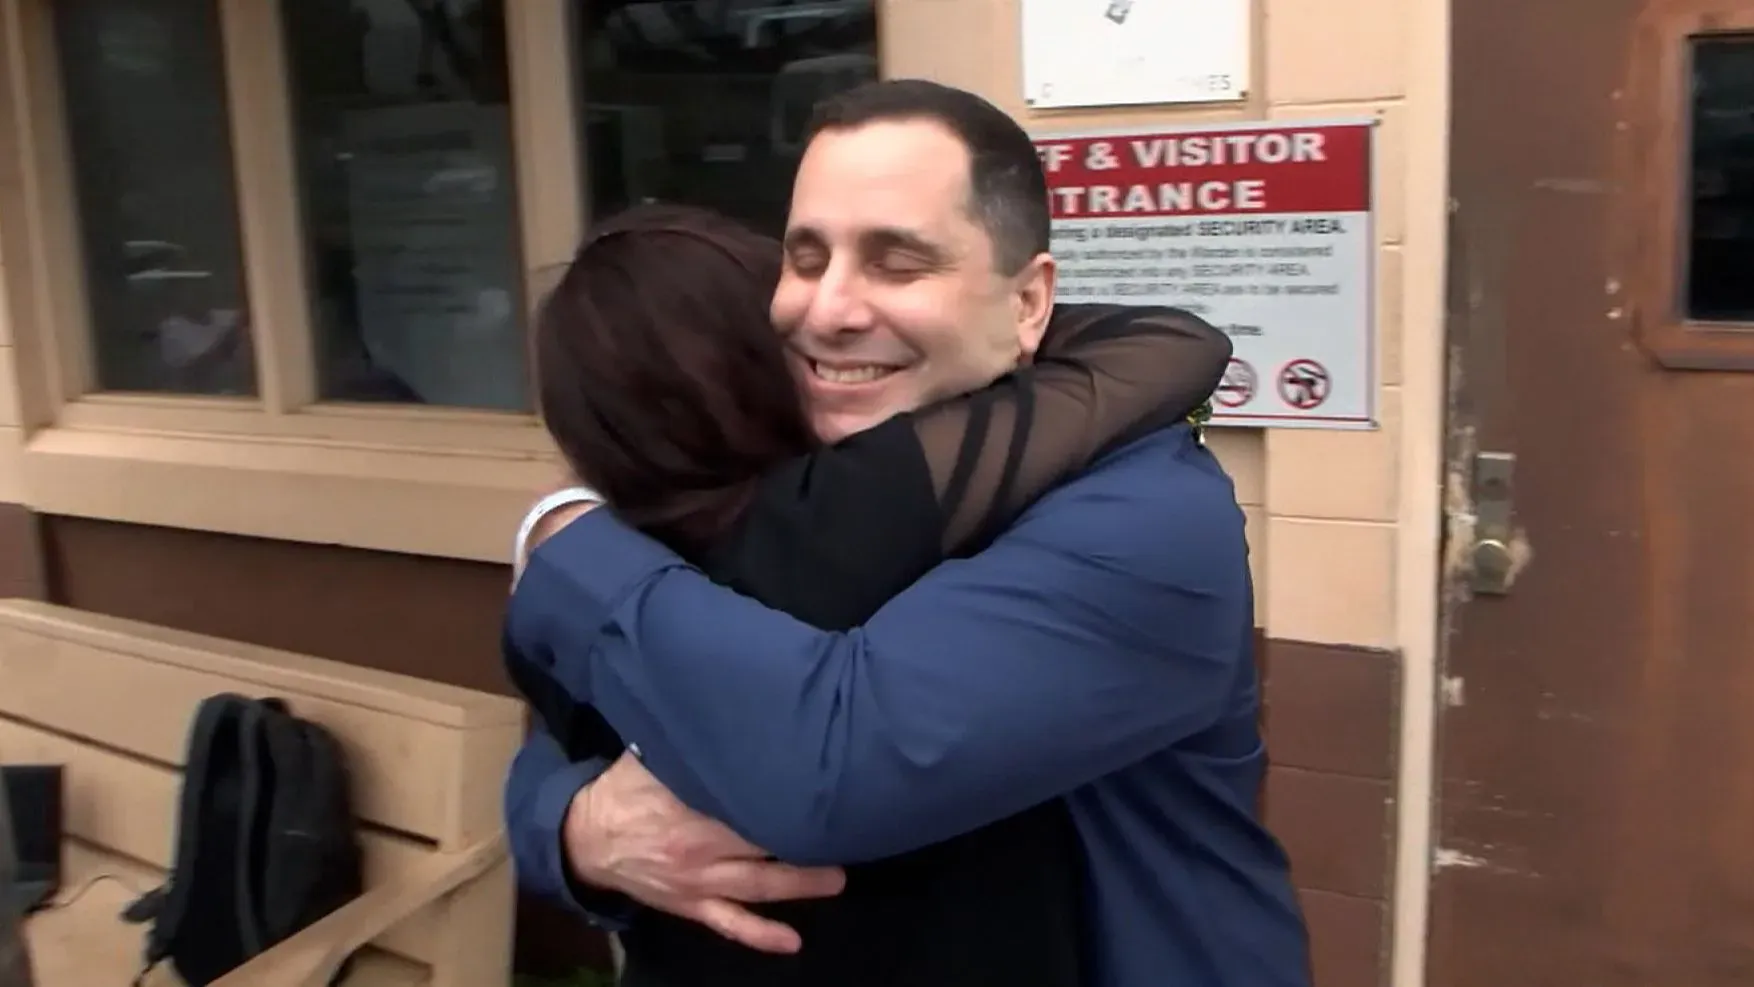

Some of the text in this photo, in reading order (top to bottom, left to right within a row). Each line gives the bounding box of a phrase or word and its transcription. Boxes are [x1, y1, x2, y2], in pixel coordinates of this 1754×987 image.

[1084, 141, 1121, 170] &
[1130, 132, 1327, 168] VISITOR
[1050, 180, 1267, 214] TRANCE
[1106, 223, 1192, 241] designated
[1197, 220, 1286, 236] SECURITY
[1289, 218, 1347, 234] AREA.
[1193, 263, 1264, 277] SECURITY
[1113, 282, 1179, 296] SECURITY
